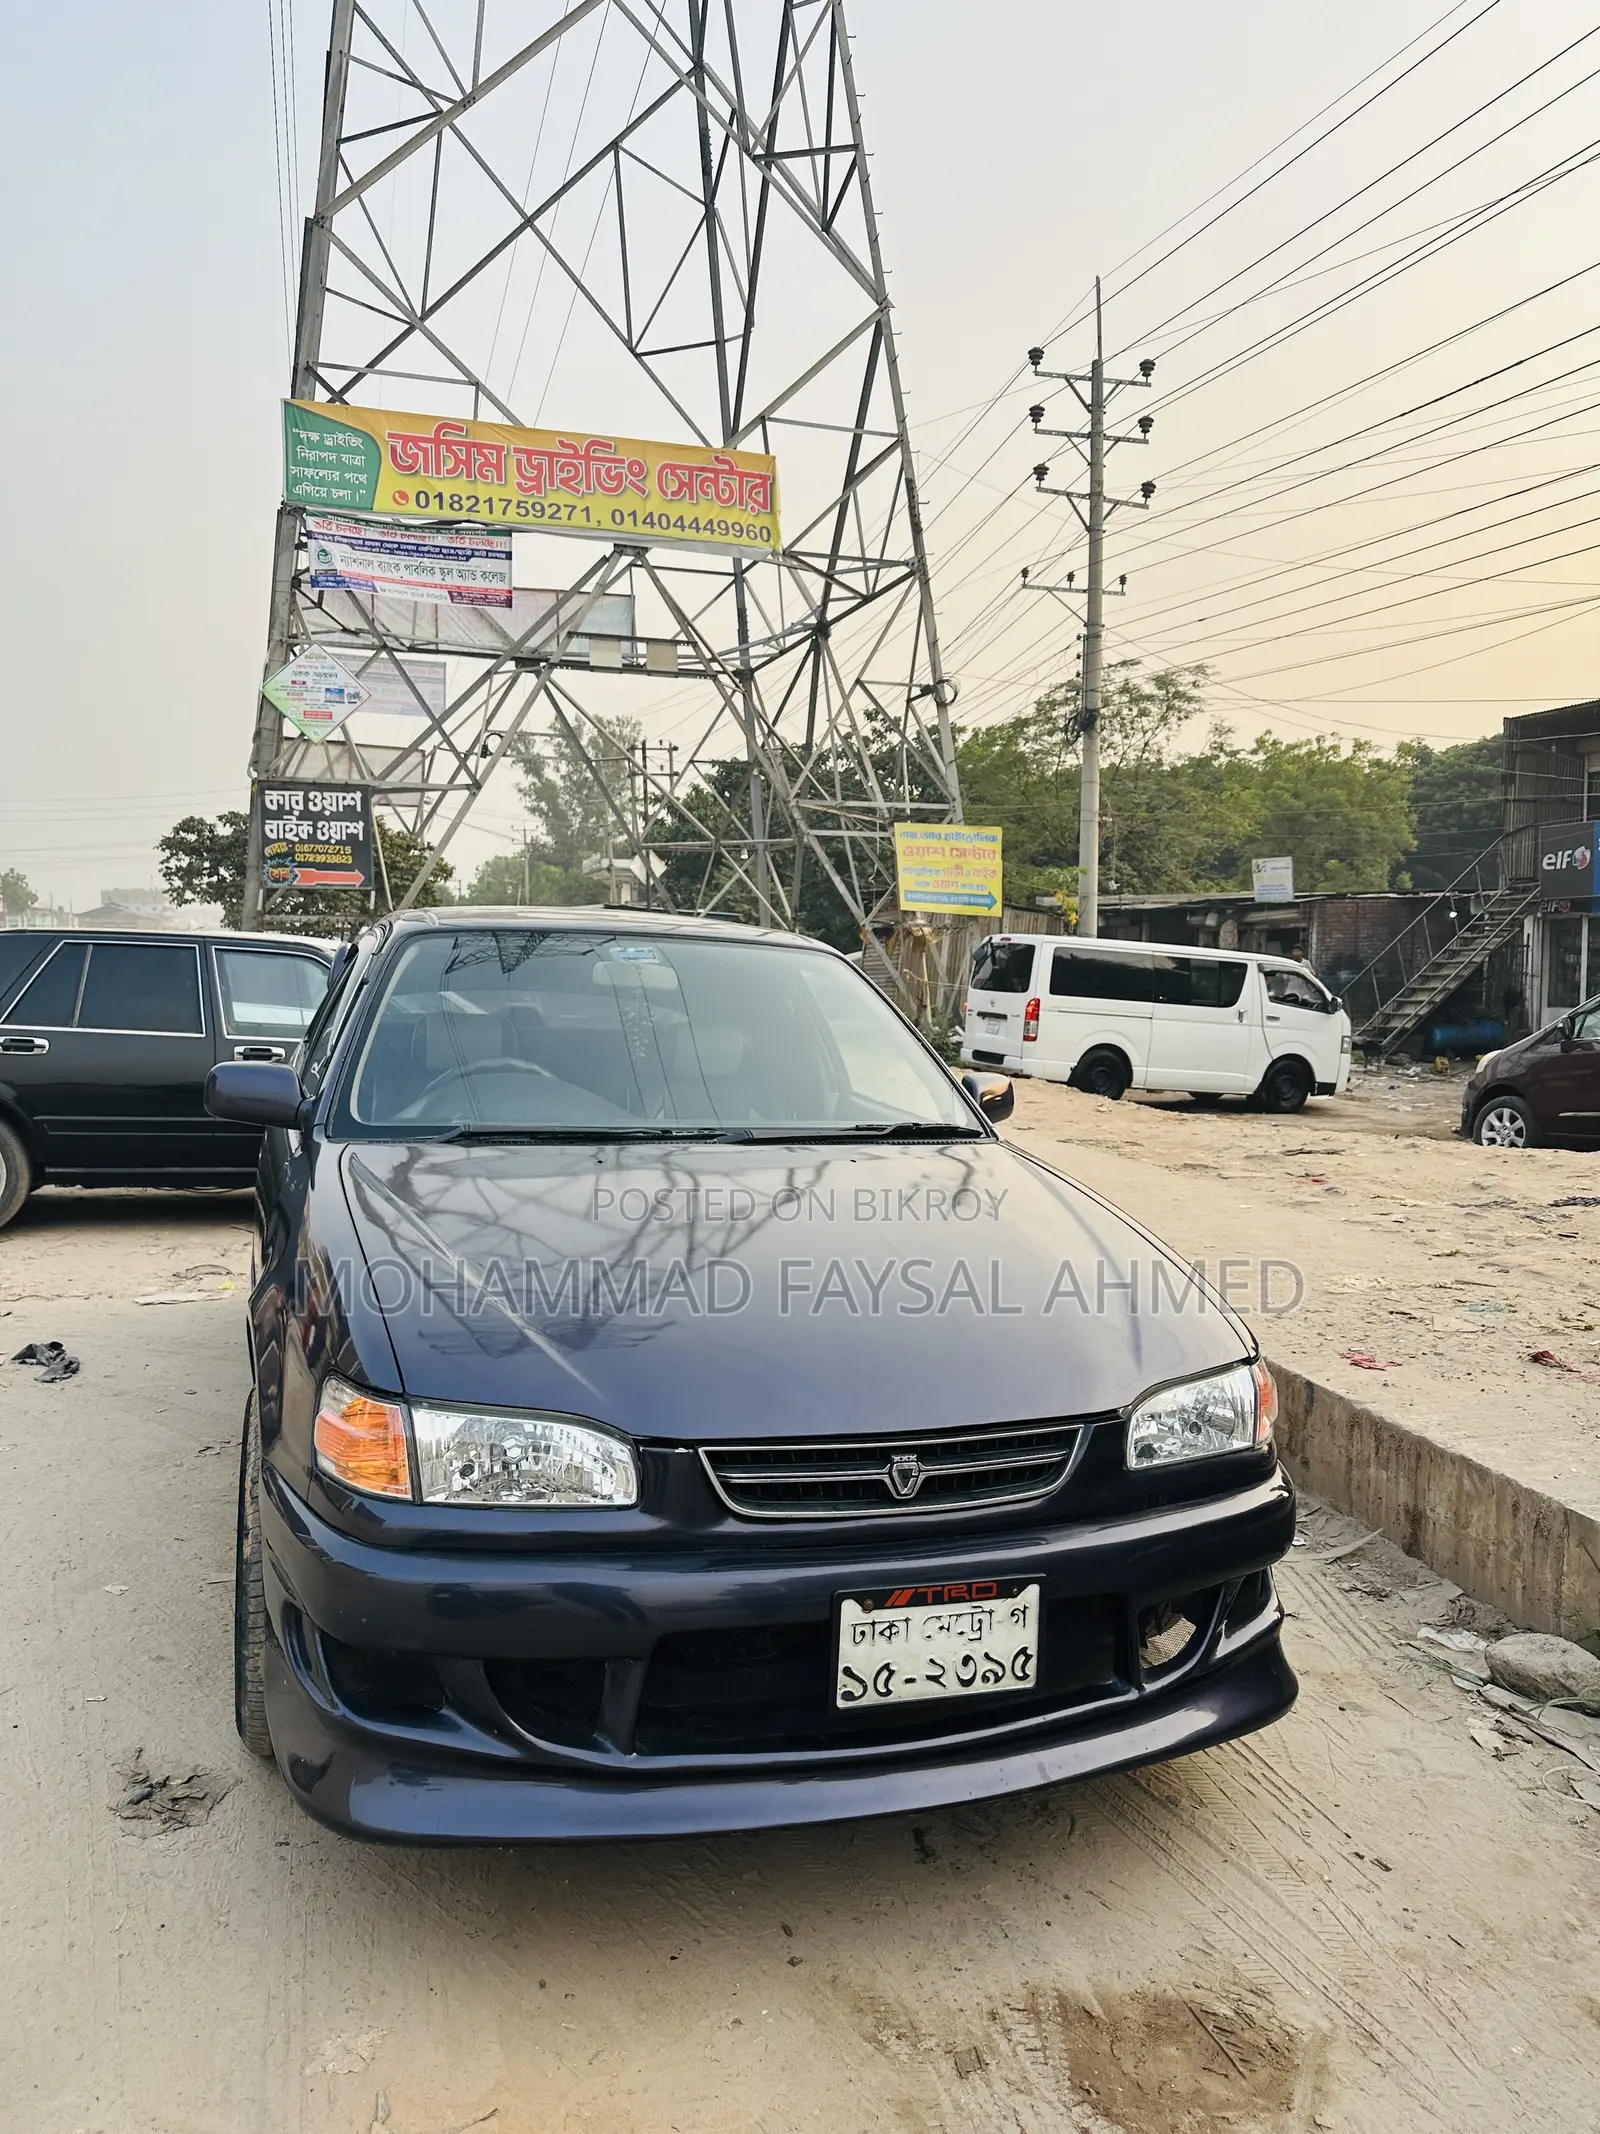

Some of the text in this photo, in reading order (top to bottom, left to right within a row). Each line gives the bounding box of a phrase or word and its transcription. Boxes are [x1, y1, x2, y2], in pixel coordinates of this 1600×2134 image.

[323, 431, 364, 450] ড্রাইভিং
[296, 445, 366, 467] নিরাপদ যাত্রা
[386, 421, 772, 516] জসিম ড্রাইভিং সেন্টার
[290, 466, 368, 485] সাফল্যের পথে
[292, 482, 328, 498] এগিয়ে
[611, 508, 771, 543] 01404449960
[339, 554, 375, 571] ন্যাশনাল
[377, 559, 402, 573] ব্যাংক
[403, 561, 436, 577] পাবলিক
[439, 566, 454, 582] স্কুল
[480, 571, 507, 585] কলেজ
[264, 790, 362, 816] কার ওয়াশ
[264, 815, 364, 844] বাইক ওয়াশ
[1542, 850, 1572, 870] elf
[916, 1582, 998, 1604] TRD
[851, 1616, 912, 1646] ঢাকা
[840, 1646, 1034, 1701] ১৫-২৩৯৫
